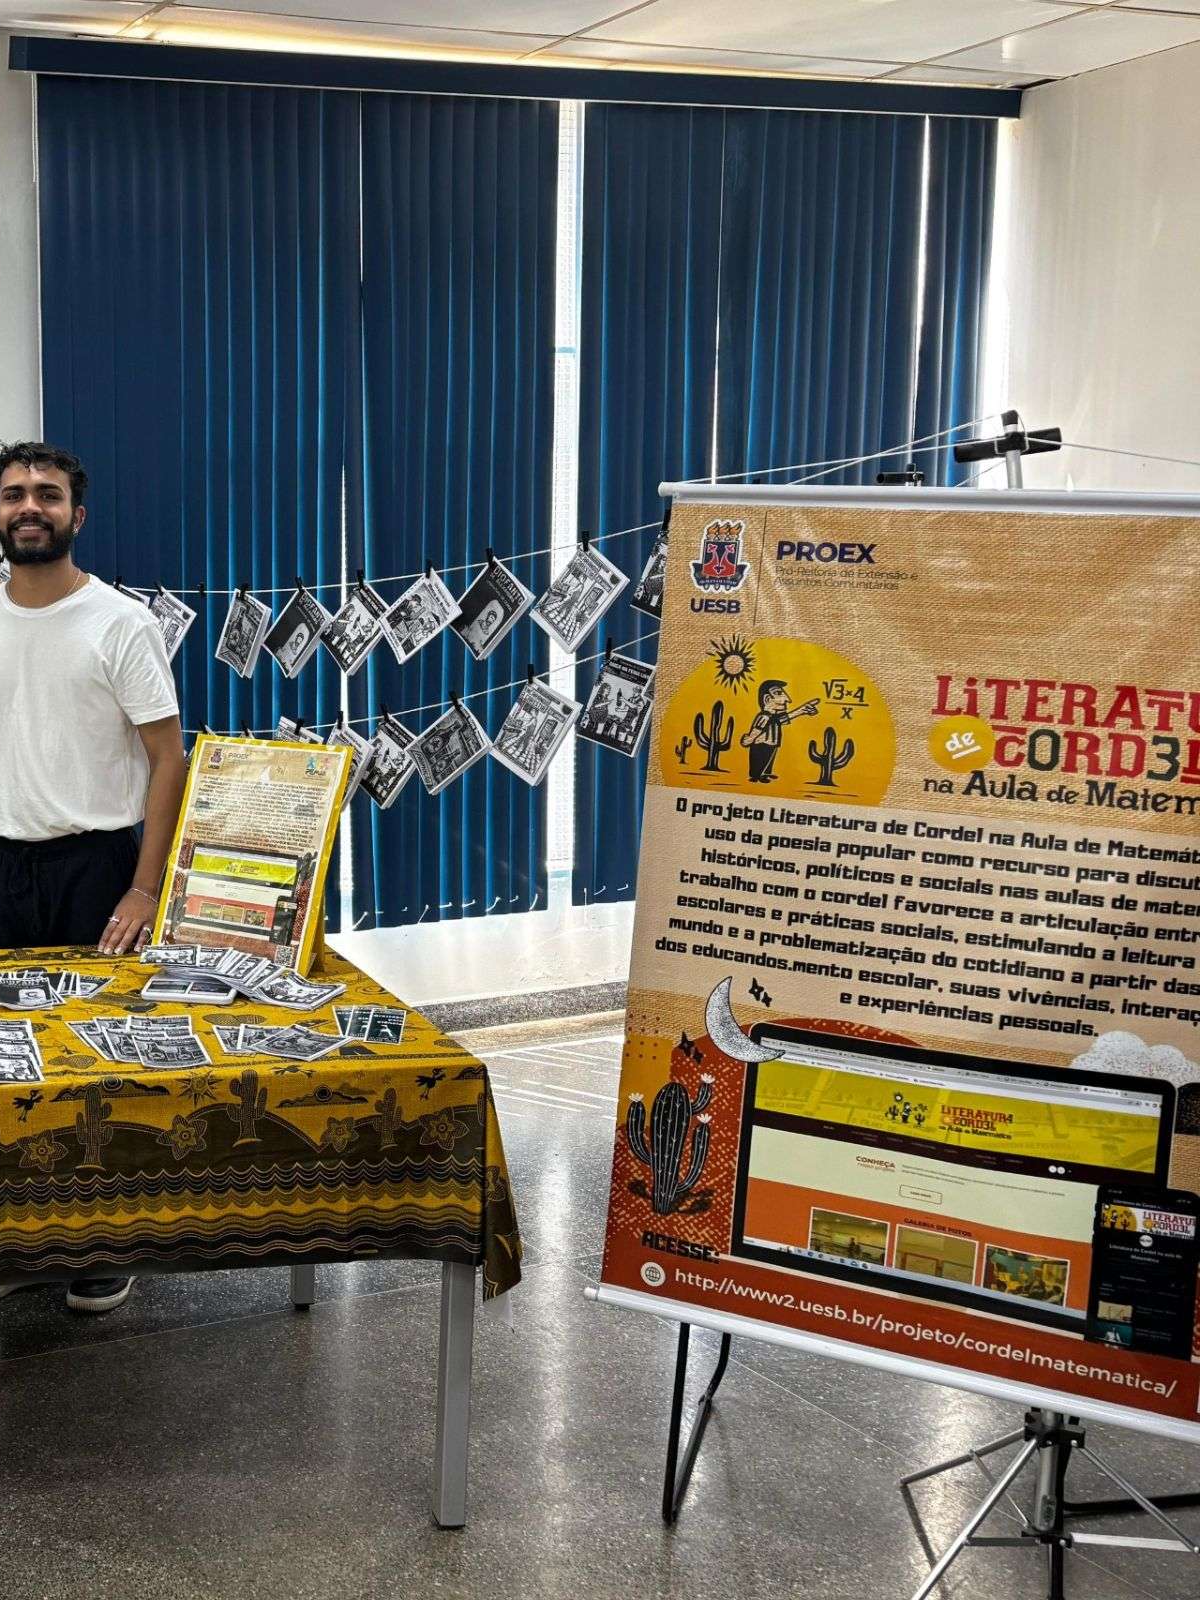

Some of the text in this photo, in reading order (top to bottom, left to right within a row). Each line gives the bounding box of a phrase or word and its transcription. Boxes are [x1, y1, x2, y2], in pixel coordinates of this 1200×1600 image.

[776, 540, 878, 564] PROEX
[690, 597, 741, 614] UESB
[944, 730, 977, 753] de
[923, 777, 954, 794] na
[962, 770, 1039, 801] Aula
[1046, 784, 1080, 805] de
[675, 797, 688, 812] O
[691, 802, 764, 822] projeto
[769, 807, 877, 833] Literatura
[882, 819, 908, 835] de
[913, 821, 984, 843] Cordel
[988, 832, 1015, 846] na
[1020, 832, 1067, 851] Aula
[1074, 837, 1101, 854] de
[703, 827, 736, 842] uso
[741, 829, 763, 845] da
[767, 835, 832, 852] poesia
[836, 842, 916, 861] popular
[921, 851, 974, 868] como
[980, 857, 1070, 877] recurso
[1075, 867, 1130, 884] para
[679, 869, 757, 893] trabalho
[762, 883, 799, 898] com
[803, 888, 816, 900] o
[821, 890, 888, 909] cordel
[893, 895, 994, 921] favorece
[1000, 911, 1014, 924] a
[1019, 913, 1149, 940] articulação
[805, 862, 895, 884] políticos
[900, 874, 913, 886] e
[918, 876, 993, 895] sociais
[999, 885, 1039, 900] nas
[1044, 888, 1105, 908] aulas
[1111, 894, 1138, 911] de
[668, 917, 1200, 996] mundo e a problematização do cotidiano a partir das
[676, 895, 766, 918] escolares
[770, 908, 783, 921] e
[787, 910, 875, 932] práticas
[964, 932, 1096, 959] estimulando
[1101, 949, 1116, 961] a
[1121, 946, 1195, 969] leitura
[654, 936, 687, 953] dos
[949, 982, 1000, 999] suas
[839, 992, 1099, 1037] e experiências pessoais.
[642, 1231, 720, 1264] ACESSE:
[674, 1268, 1178, 1398] http://www2.uesb.br/projeto/cordelmatematica/
